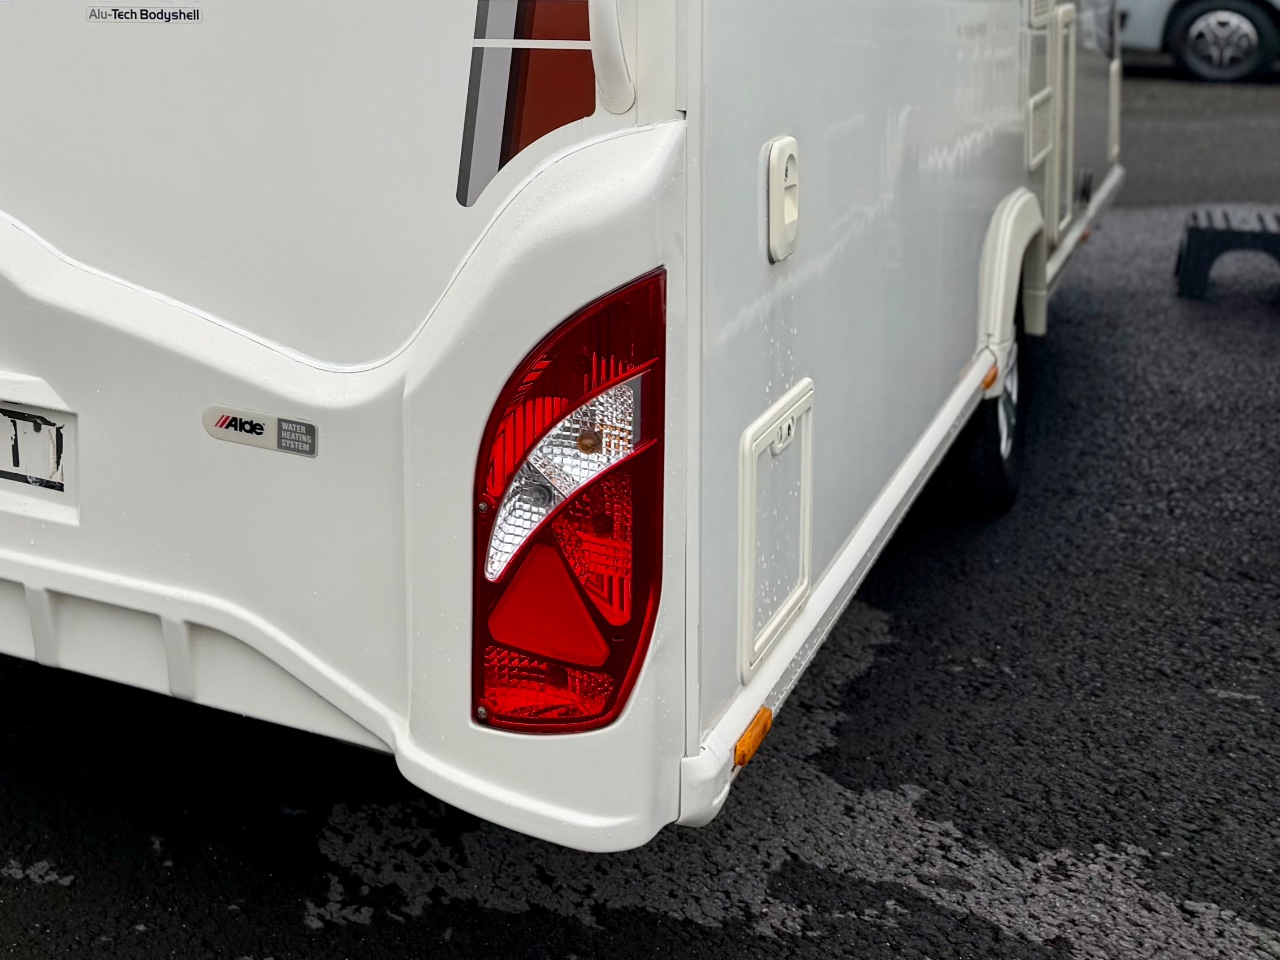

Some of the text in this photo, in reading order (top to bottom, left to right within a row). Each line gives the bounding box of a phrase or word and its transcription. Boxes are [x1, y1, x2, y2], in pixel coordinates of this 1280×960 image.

[89, 8, 200, 22] Alu-Tech Bodyshell
[224, 416, 264, 435] Alde
[281, 422, 306, 434] WATER
[281, 430, 312, 444] HEATING
[281, 439, 310, 452] SYSTEM
